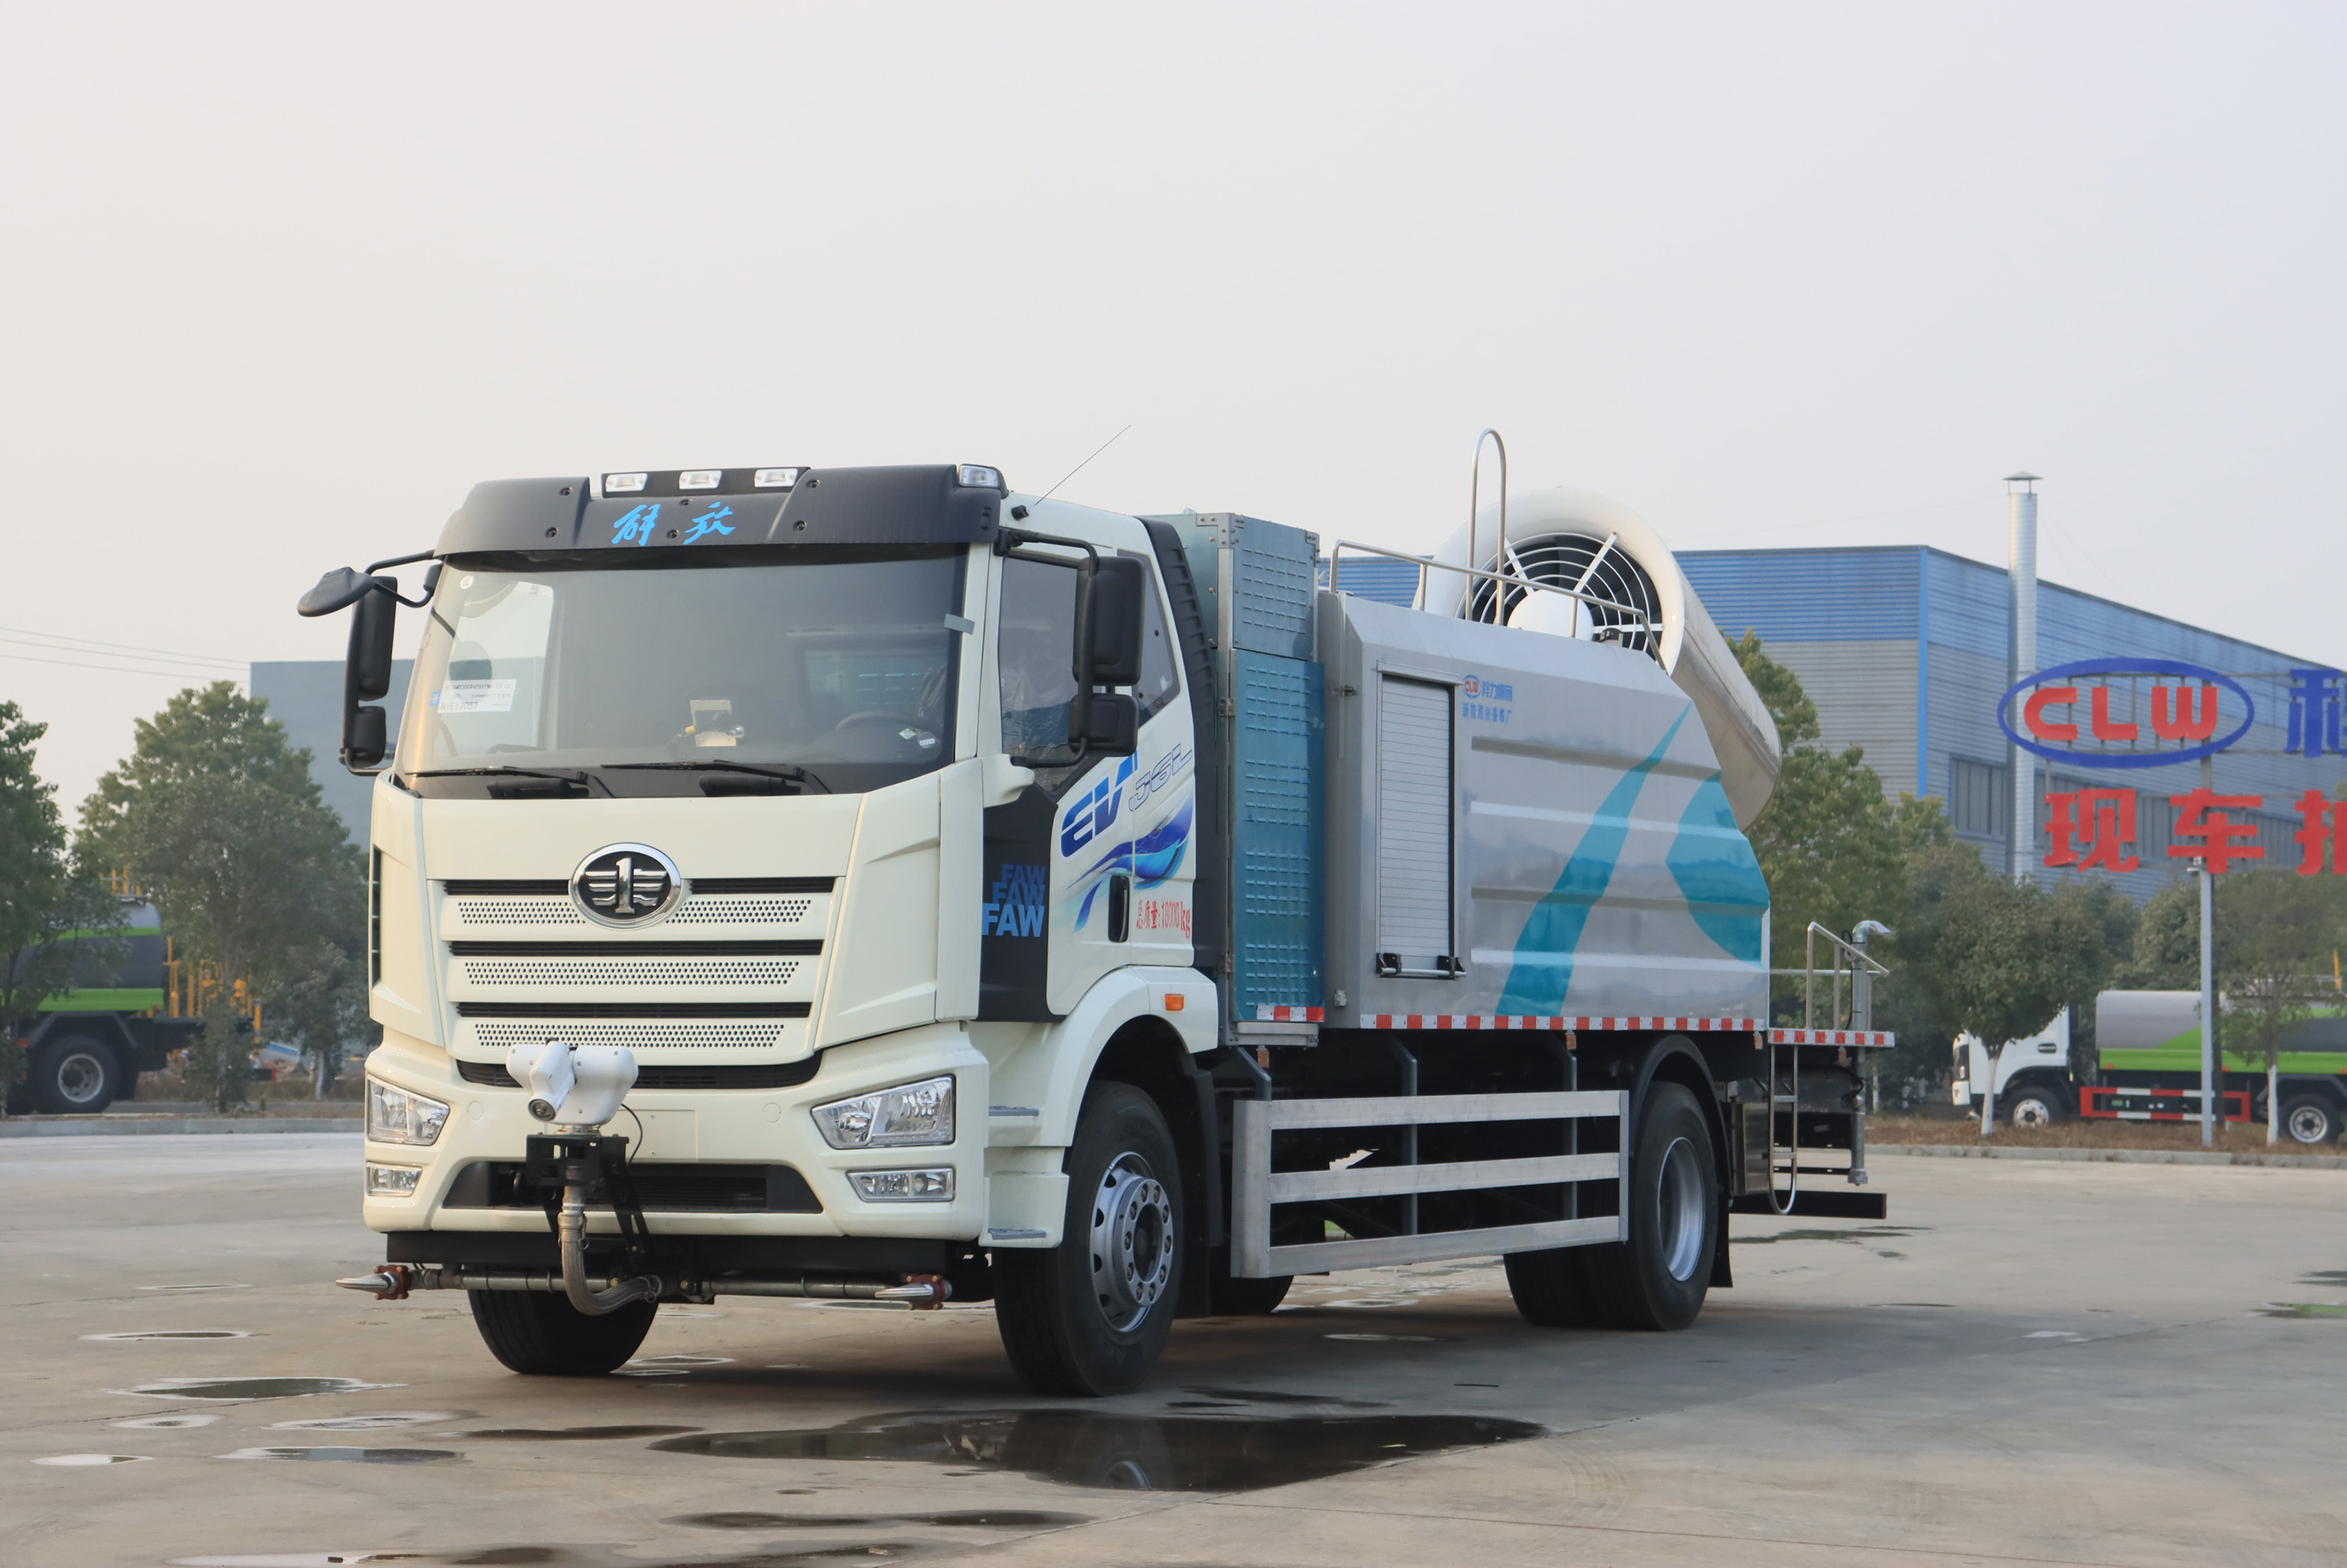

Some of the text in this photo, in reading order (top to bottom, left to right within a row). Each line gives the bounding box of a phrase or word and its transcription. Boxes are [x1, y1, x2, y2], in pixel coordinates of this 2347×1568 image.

[2024, 686, 2218, 741] CLW
[1128, 742, 1192, 812] J6L
[1001, 864, 1047, 883] FAW
[992, 882, 1045, 906] FAW
[981, 903, 1045, 937] FAW
